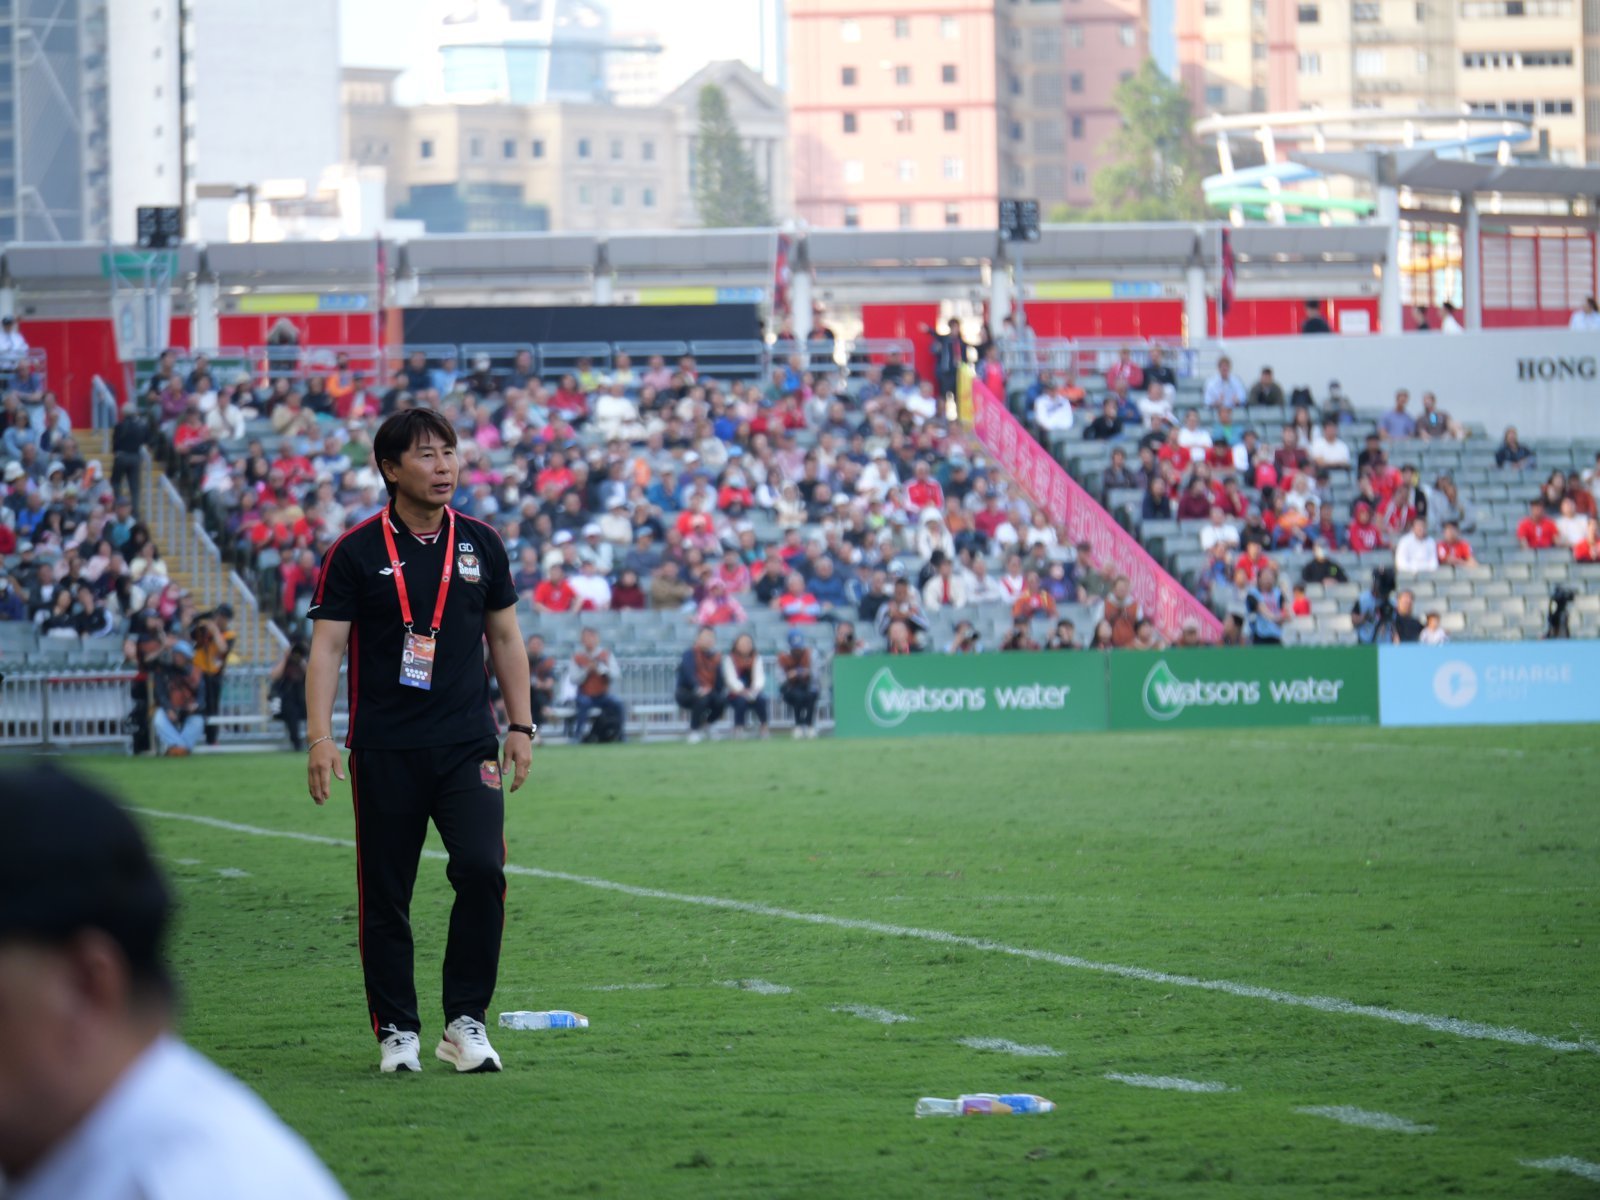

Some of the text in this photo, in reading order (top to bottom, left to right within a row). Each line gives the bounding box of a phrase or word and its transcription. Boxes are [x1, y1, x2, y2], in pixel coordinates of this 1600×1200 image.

[1517, 357, 1597, 381] HONG
[458, 543, 474, 552] GD
[1485, 663, 1573, 684] CHARGE
[994, 683, 1070, 709] water
[1269, 677, 1343, 704] water
